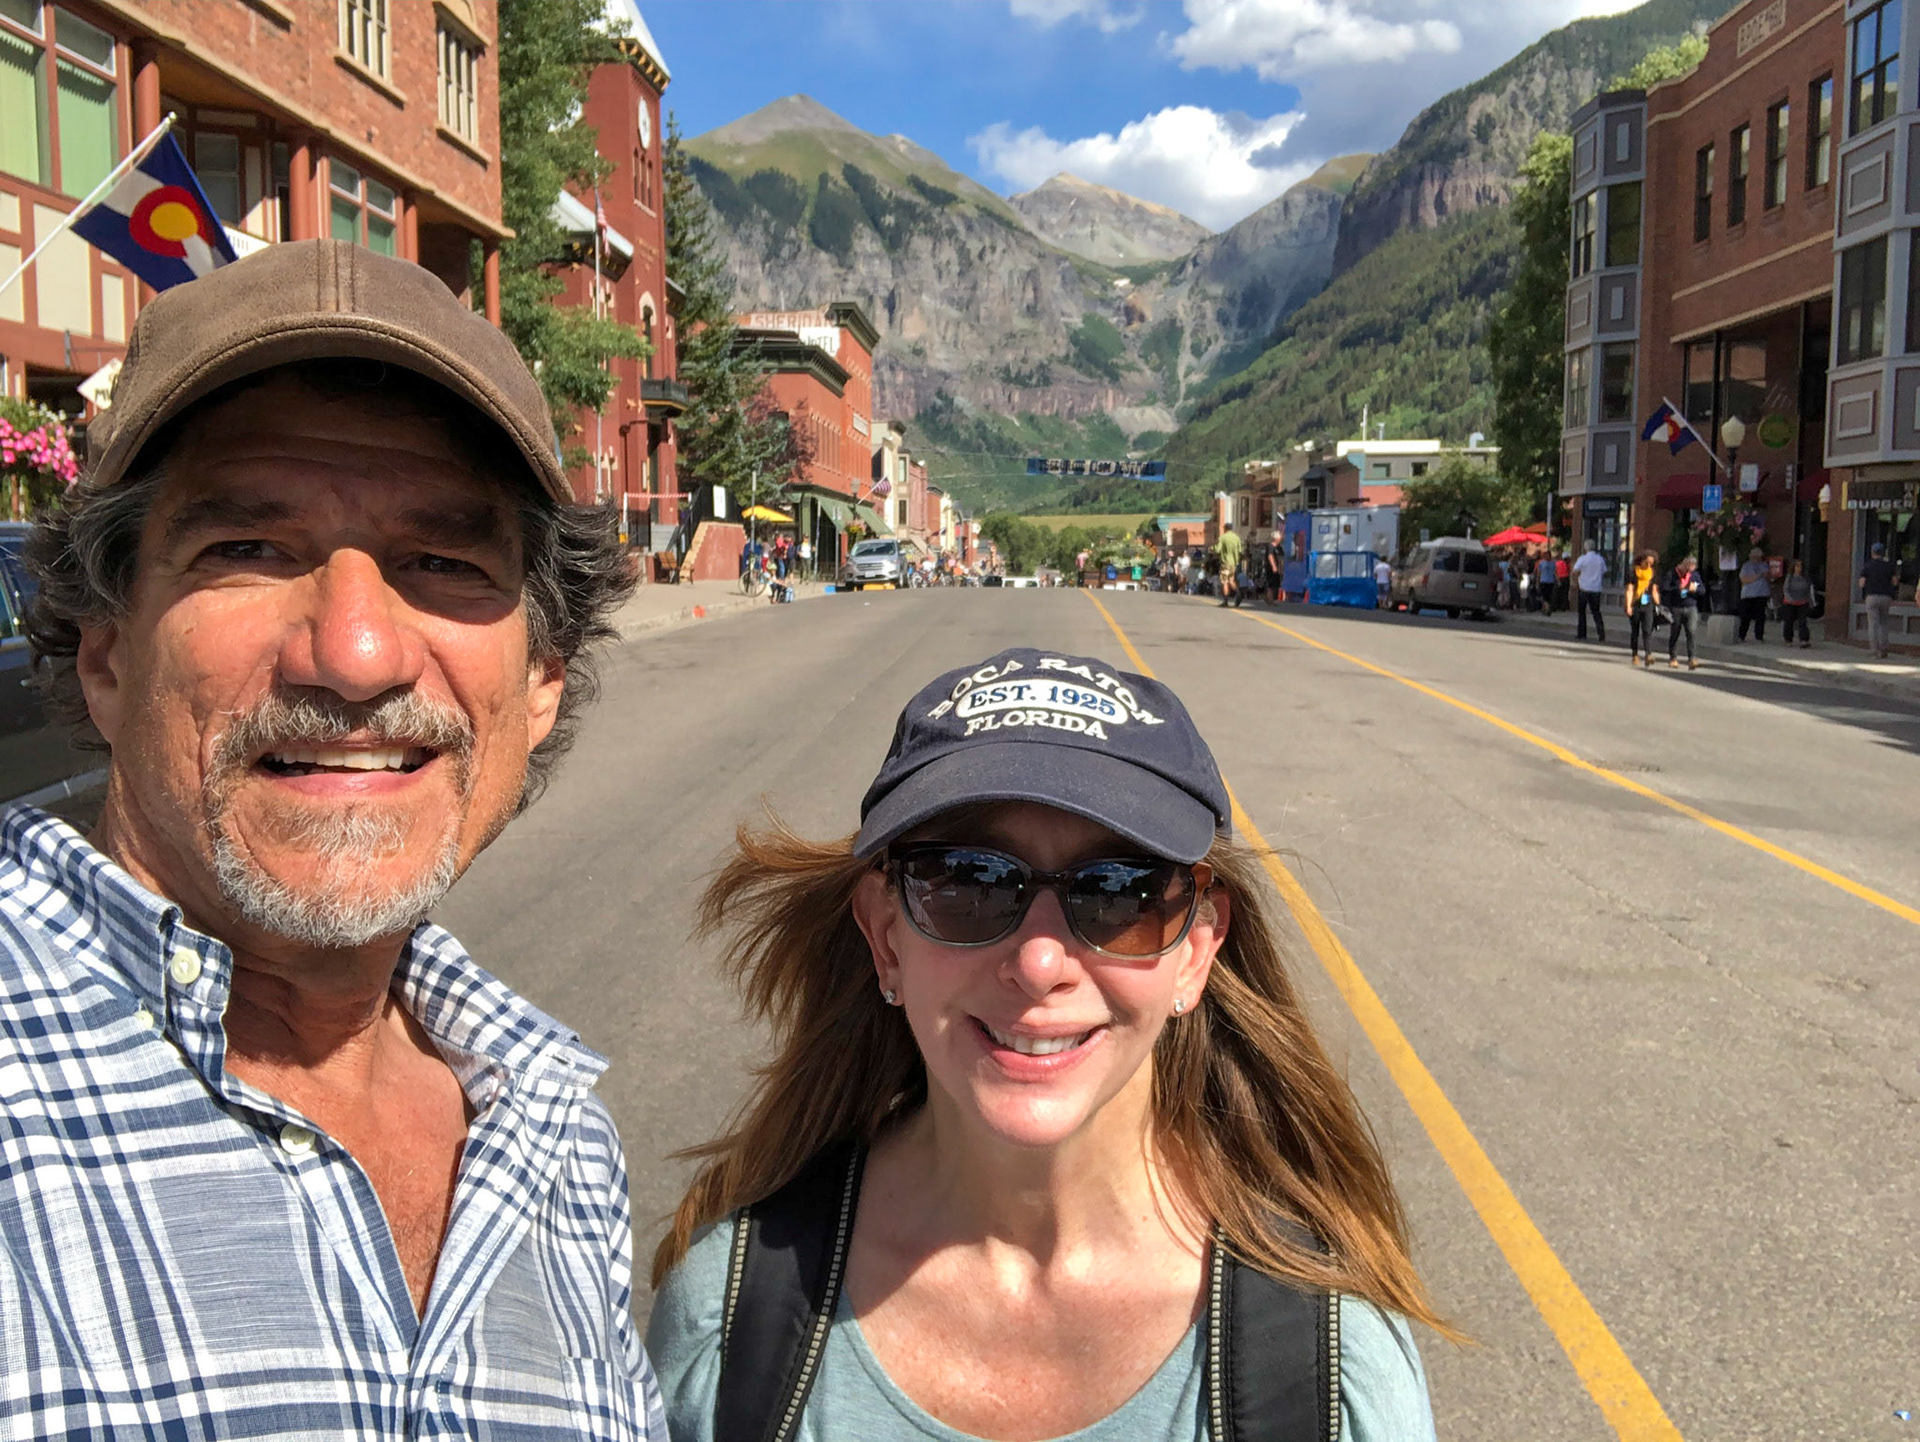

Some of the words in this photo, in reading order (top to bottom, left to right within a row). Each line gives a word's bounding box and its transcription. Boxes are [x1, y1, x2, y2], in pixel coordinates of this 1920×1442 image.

[1848, 498, 1913, 510] BURGER
[928, 660, 1024, 720] BOCA
[1036, 658, 1165, 725] RATON
[967, 685, 1036, 710] EST.
[1048, 685, 1116, 716] 1925
[964, 710, 1108, 740] FLORIDA
